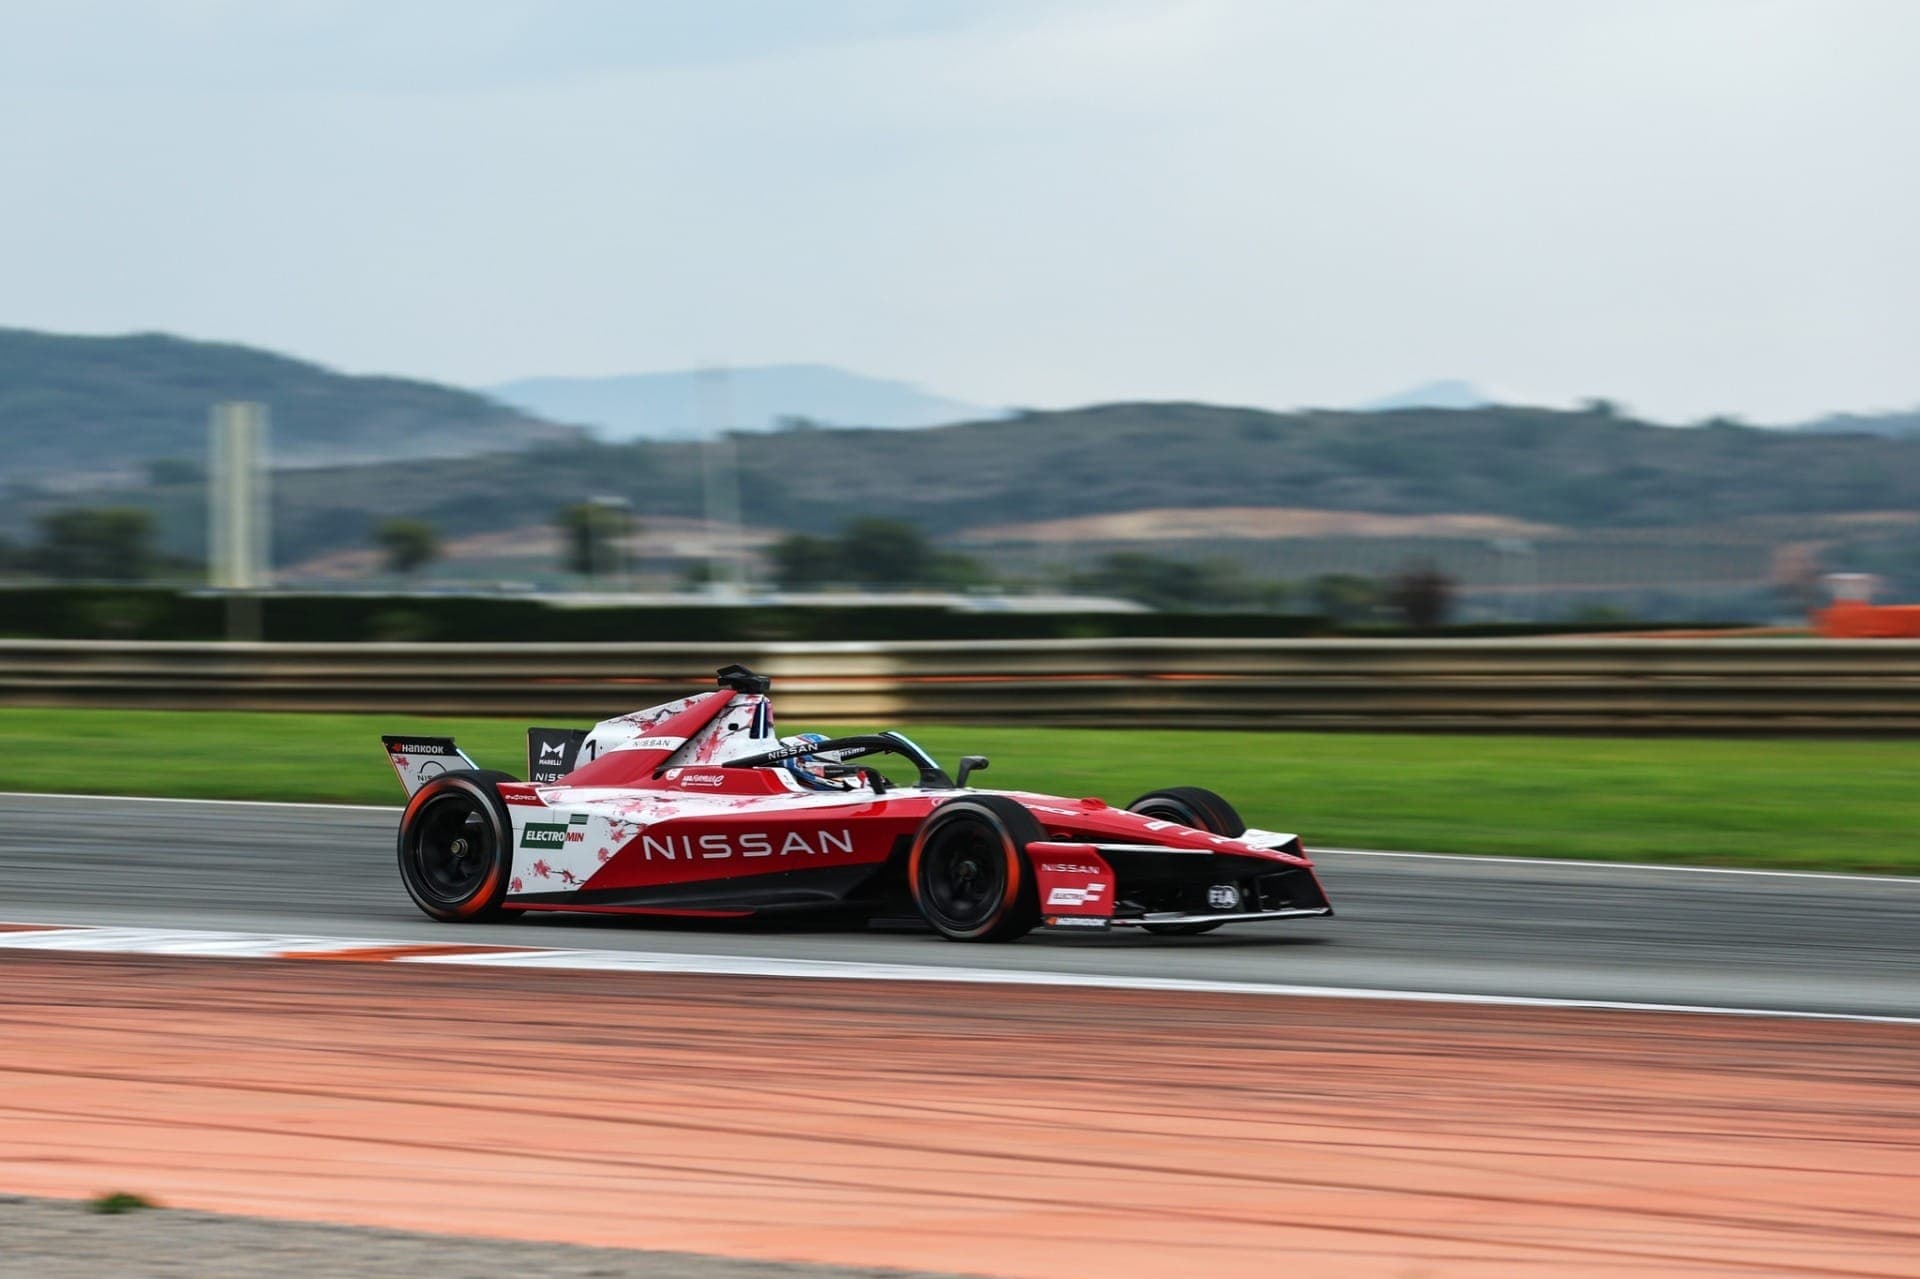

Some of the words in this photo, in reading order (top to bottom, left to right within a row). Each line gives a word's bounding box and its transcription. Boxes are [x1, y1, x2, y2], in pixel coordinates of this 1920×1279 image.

[585, 739, 597, 762] 1
[633, 739, 672, 748] NISSAN
[768, 742, 819, 760] NISSAN
[526, 830, 584, 842] ELECTROMIN
[642, 829, 853, 861] NISSAN
[1041, 863, 1100, 875] NISSAN
[1209, 889, 1237, 904] FIA
